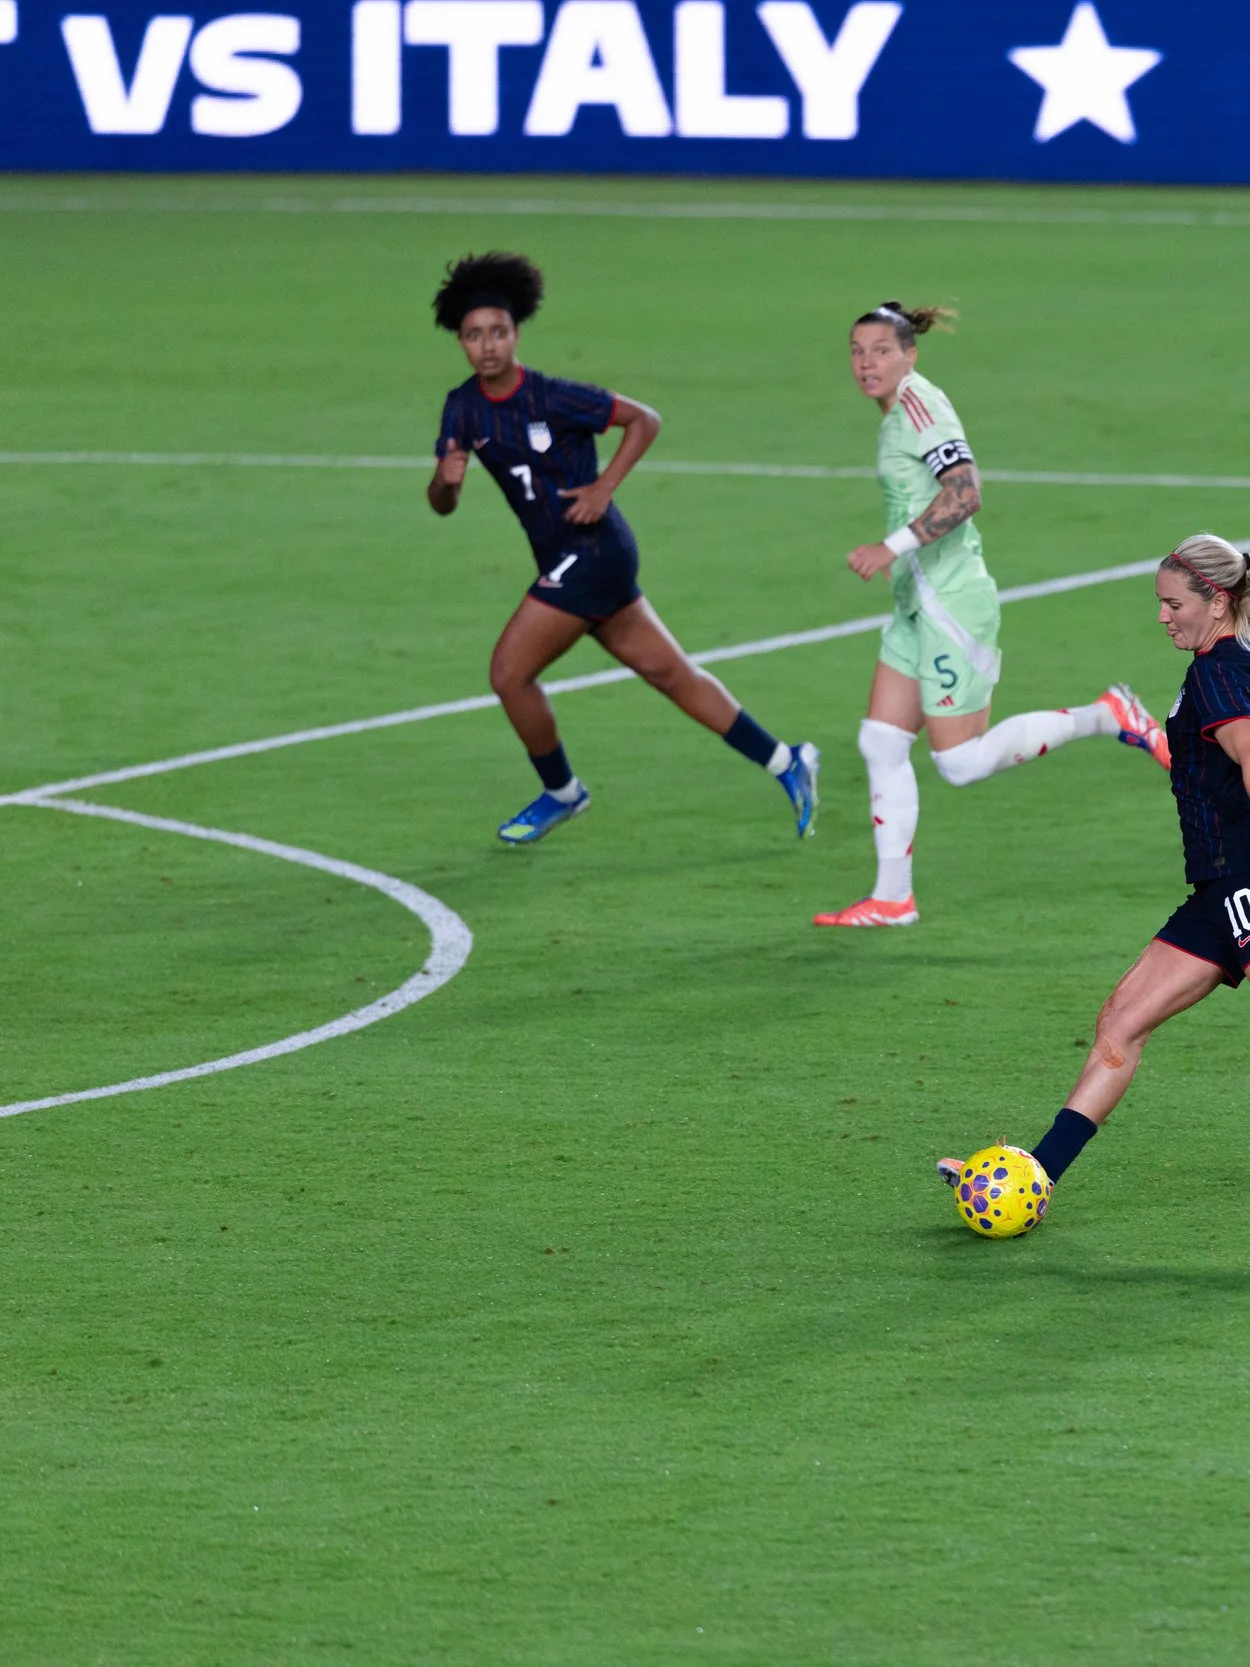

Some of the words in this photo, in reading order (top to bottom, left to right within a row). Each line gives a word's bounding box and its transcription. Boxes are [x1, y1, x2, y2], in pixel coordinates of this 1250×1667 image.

[61, 14, 302, 137] vs
[352, 0, 902, 140] ITALY
[509, 464, 536, 500] 7
[934, 655, 957, 689] 5
